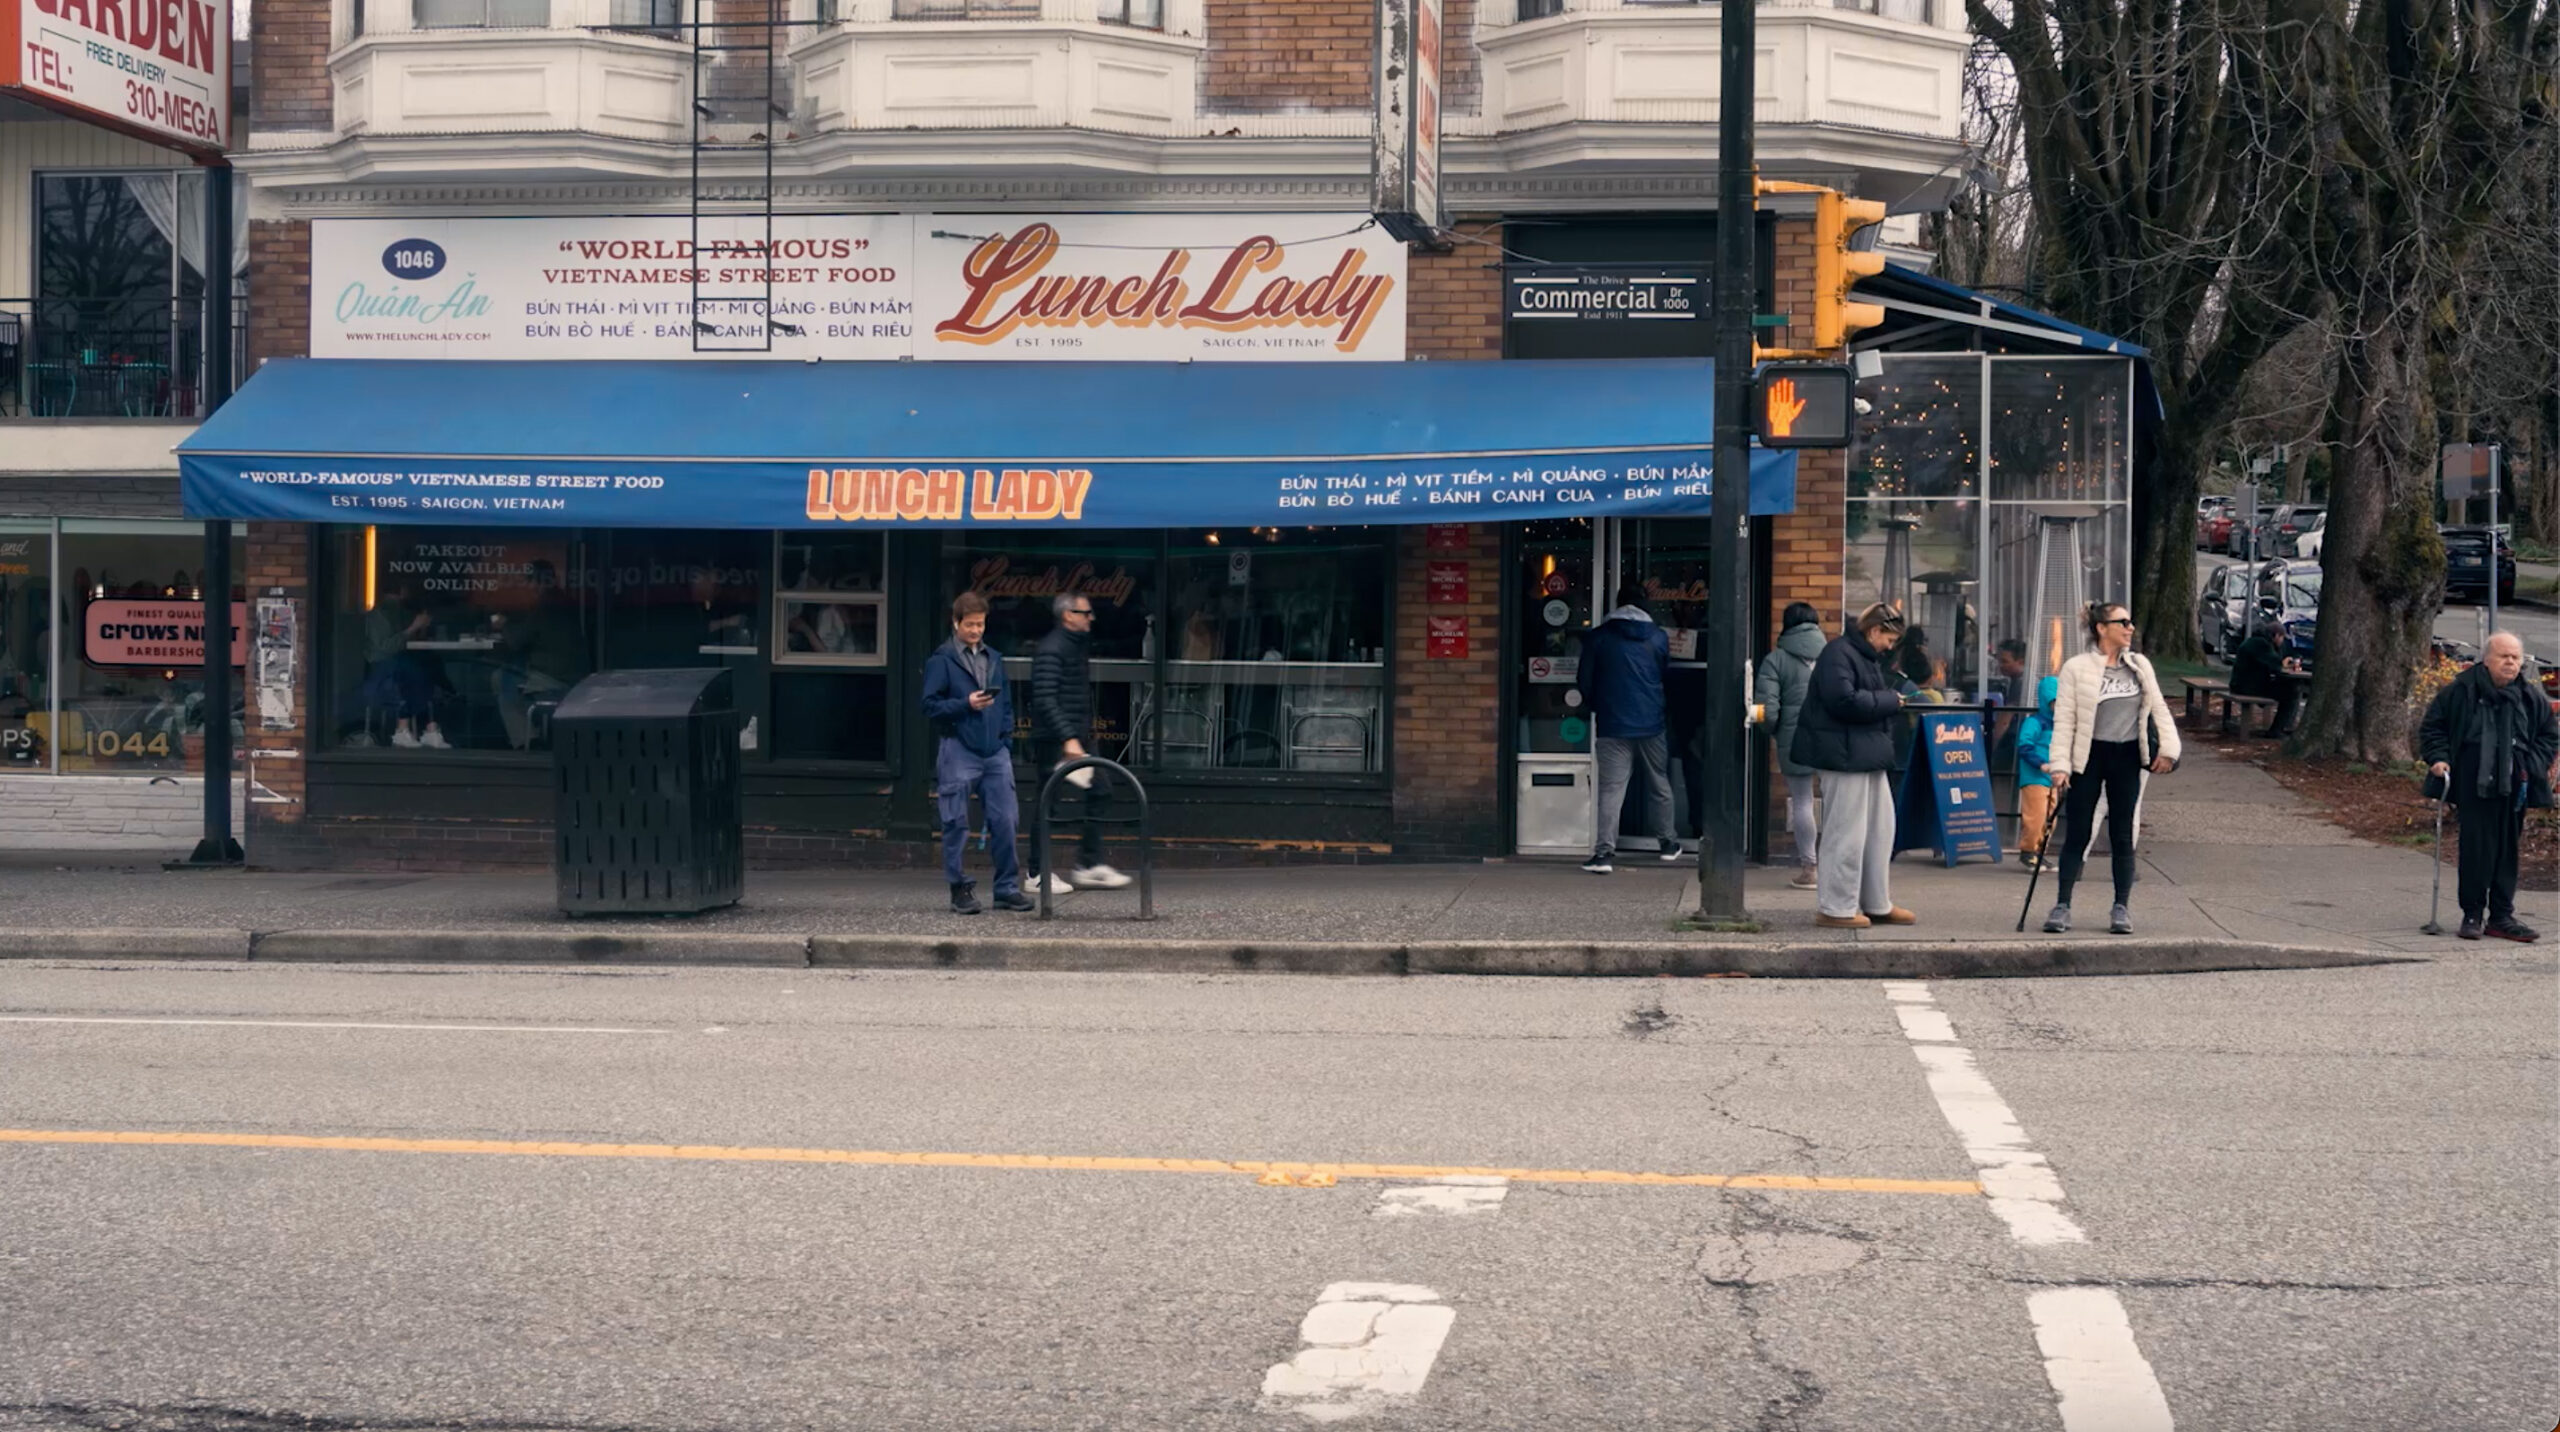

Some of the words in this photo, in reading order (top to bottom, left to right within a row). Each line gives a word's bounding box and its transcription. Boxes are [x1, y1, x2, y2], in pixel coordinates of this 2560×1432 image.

[34, 0, 216, 75] RDEN
[27, 42, 74, 93] TEL:
[86, 40, 114, 67] FREE
[117, 51, 166, 84] DELIVERY
[126, 79, 220, 142] 310-MEGA
[394, 250, 434, 269] 1046
[542, 269, 710, 283] VIETNAMESE
[719, 268, 819, 283] STREET
[828, 268, 896, 282] FOOD
[1583, 276, 1599, 285] The
[1601, 276, 1625, 285] Drive
[934, 222, 1191, 345] Lunch
[1178, 234, 1395, 352] Lady
[1670, 287, 1683, 298] Dr
[335, 281, 422, 324] Quán
[1520, 286, 1656, 309] Commercial
[1663, 298, 1689, 310] 1000
[526, 298, 561, 315] BÚN
[565, 298, 605, 315] THÁI
[618, 298, 638, 315] MÌ
[643, 302, 670, 318] VỊT
[829, 298, 866, 315] BÚN
[1605, 311, 1623, 320] 1911
[346, 332, 491, 341] WWW.THELUNCHLADY.COM
[525, 320, 561, 337] BÚN
[568, 320, 593, 337] BÒ
[600, 319, 635, 337] HUẾ
[713, 324, 763, 338] CANH
[828, 320, 864, 337] BÚN
[872, 320, 912, 338] RIÊU
[1051, 338, 1083, 347] 1995
[1264, 338, 1326, 347] VIETNAM
[240, 471, 403, 485] “WORLD-FAMOUS”
[408, 472, 531, 487] VIETNAMESE
[536, 475, 609, 488] STREET
[614, 476, 664, 489] FOOD
[1280, 474, 1318, 490] BÚN
[1324, 473, 1367, 489] THÁI
[1386, 472, 1407, 488] MÌ
[1415, 473, 1445, 489] VỊT
[1512, 467, 1533, 483] MÌ
[1540, 465, 1607, 484] QUẢNG
[1627, 464, 1665, 481] BÚN
[331, 495, 364, 507] EST.
[369, 496, 408, 508] 1995
[493, 497, 565, 509] VIETNAM
[806, 468, 965, 521] LUNCH
[970, 468, 1093, 521] LADY
[1279, 492, 1316, 508] BÚN
[1327, 492, 1355, 507] BÒ
[1365, 489, 1402, 505] HUẾ
[1429, 488, 1481, 504] BÁNH
[1492, 489, 1545, 503] CANH
[1556, 488, 1595, 502] CUA
[1624, 484, 1662, 500] BÚN
[415, 544, 507, 558] TAKEOUT
[388, 560, 433, 574] NOW
[438, 561, 534, 575] AVAILBLE
[423, 578, 499, 592] ONLINE
[968, 554, 1060, 598] Lunch
[1056, 560, 1137, 608] Lady
[127, 609, 163, 619] FINEST
[167, 610, 206, 619] QUALI
[185, 626, 240, 642] NT
[127, 646, 206, 657] BARBERSHO
[0, 729, 32, 748] PS
[85, 730, 171, 757] 1044
[1944, 750, 1973, 764] OPEN
